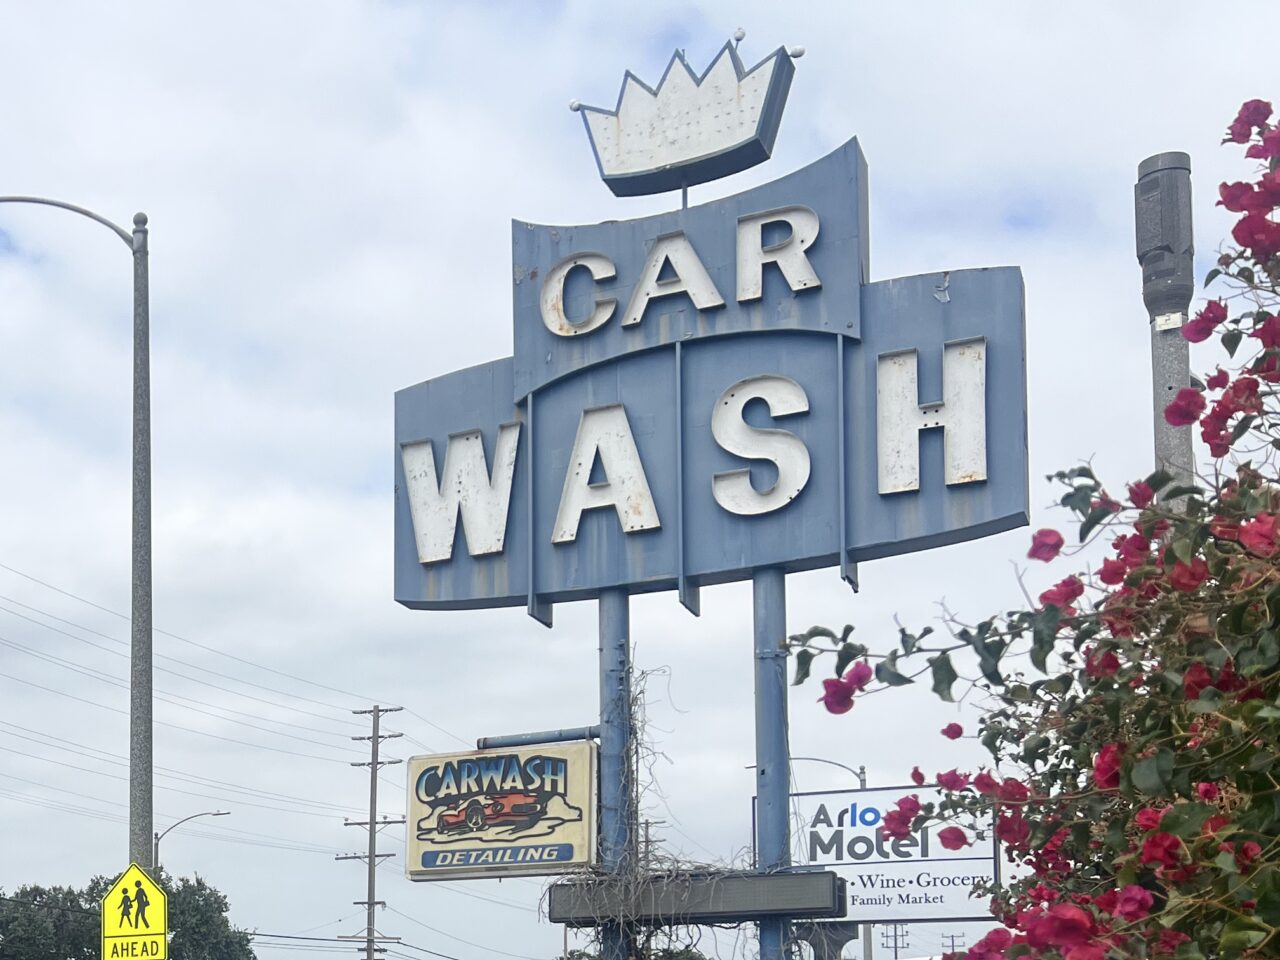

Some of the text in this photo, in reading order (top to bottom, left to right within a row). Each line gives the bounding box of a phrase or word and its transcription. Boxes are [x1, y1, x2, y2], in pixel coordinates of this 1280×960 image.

[539, 204, 823, 338] CAR
[399, 336, 989, 566] WASH
[416, 754, 568, 803] CARWASH
[810, 802, 881, 828] Arlo
[435, 846, 559, 866] DETAILING
[809, 826, 929, 862] Motel
[857, 874, 906, 889] Wine
[851, 893, 944, 908] Family Market
[111, 940, 159, 958] AHEAD
